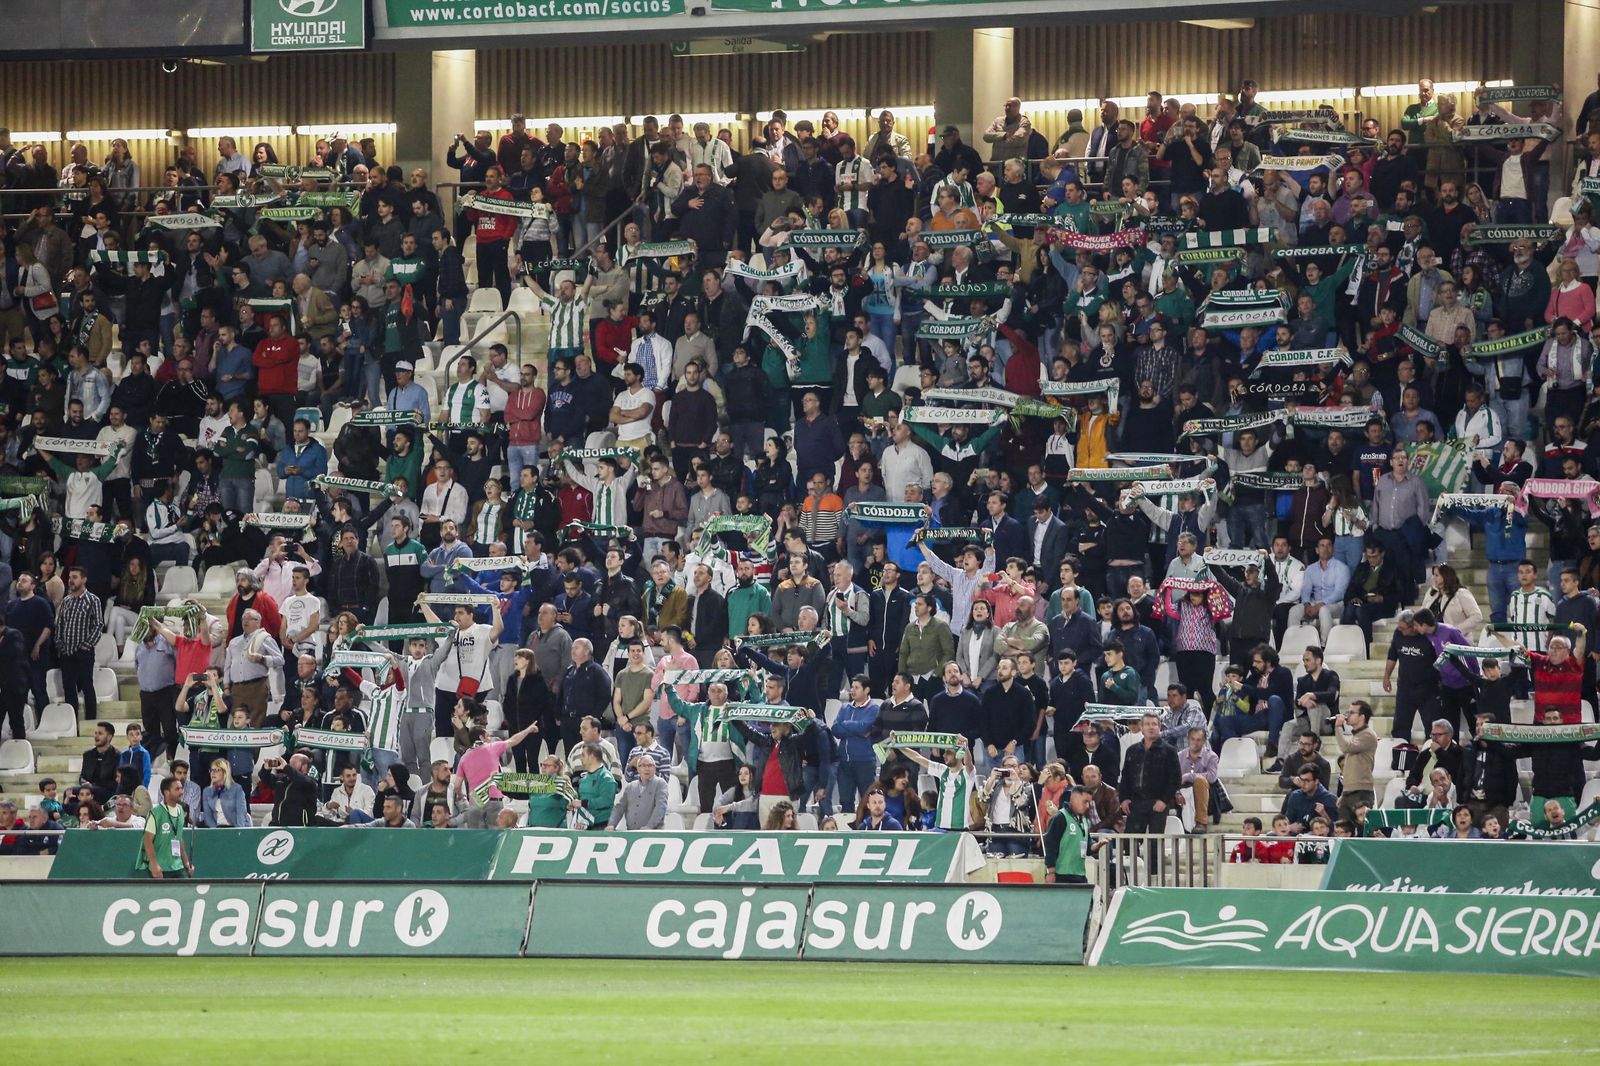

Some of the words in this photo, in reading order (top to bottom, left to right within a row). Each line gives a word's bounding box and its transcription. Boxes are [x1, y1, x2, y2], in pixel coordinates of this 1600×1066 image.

[271, 20, 346, 36] HYUNDAI
[271, 36, 325, 45] CORHYUND
[1314, 109, 1339, 123] MADRID
[794, 232, 842, 243] CÓRDOBA
[842, 234, 856, 243] CF
[1073, 239, 1118, 249] CORDOBESA
[1085, 235, 1110, 243] MUJER
[864, 505, 916, 518] CÓRDOBA
[774, 710, 790, 718] CF
[510, 836, 934, 875] PROCATEL
[102, 885, 384, 956] cajasur
[646, 887, 936, 960] cajasur
[1275, 904, 1440, 958] AQUA
